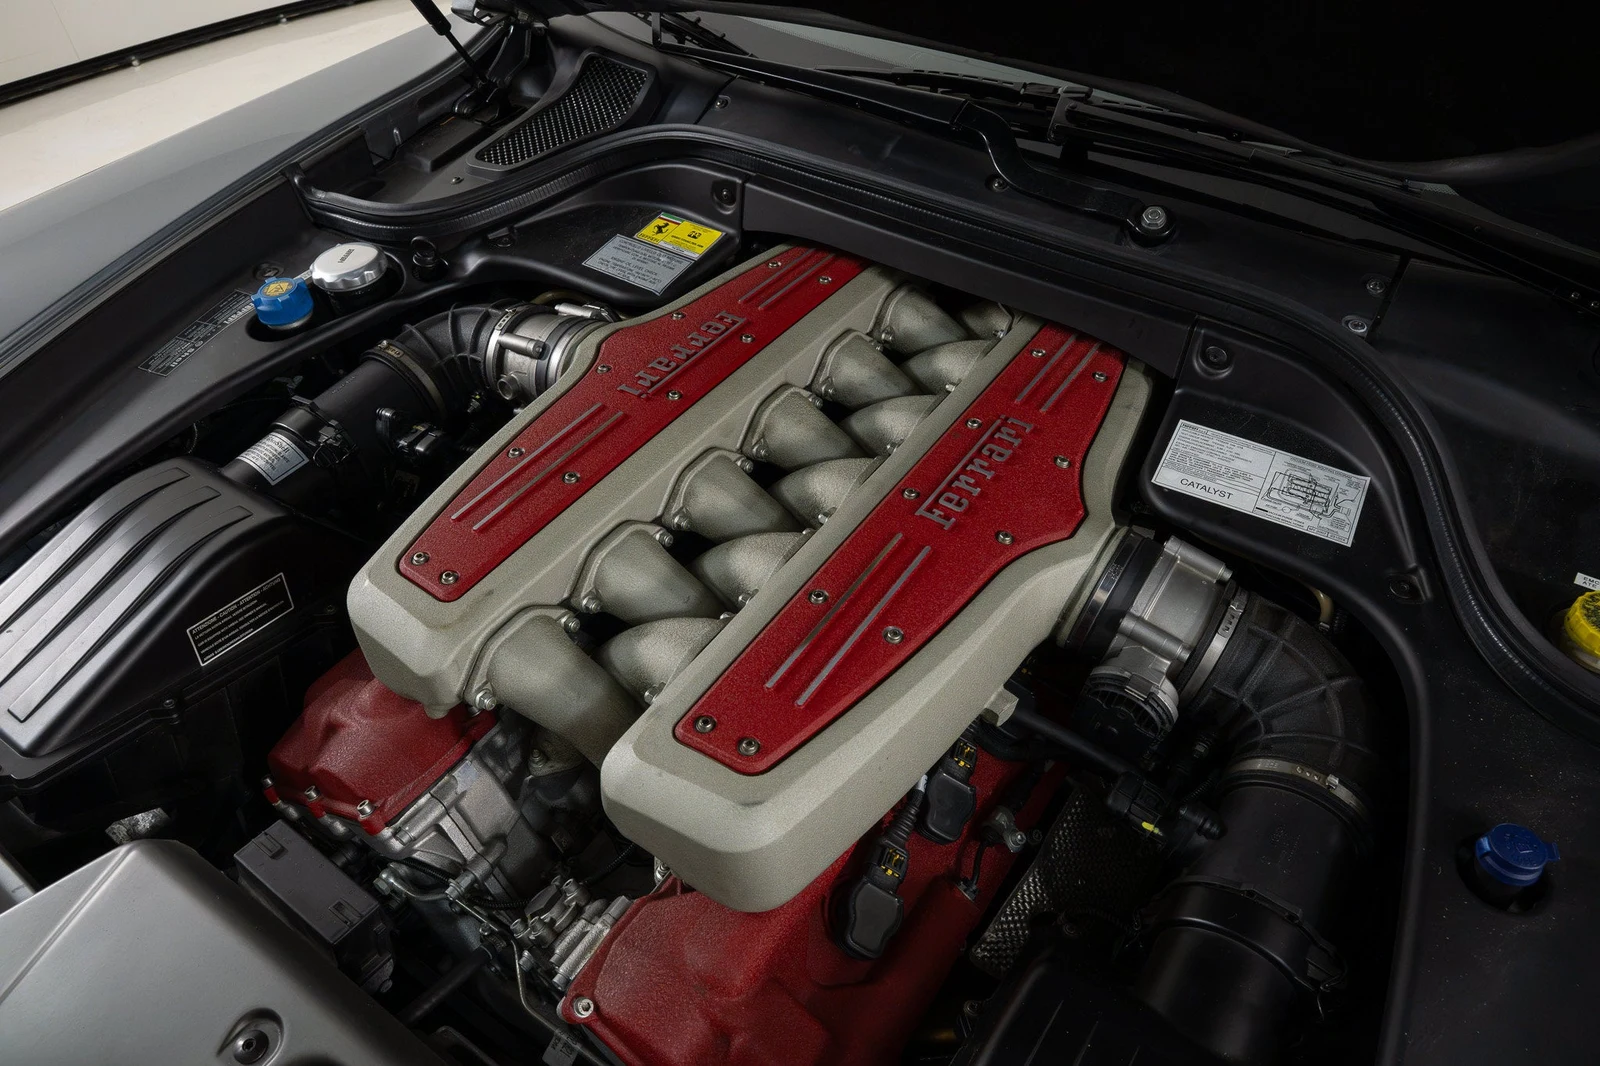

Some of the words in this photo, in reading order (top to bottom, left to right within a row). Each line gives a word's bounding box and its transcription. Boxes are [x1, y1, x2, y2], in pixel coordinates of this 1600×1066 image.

[170, 348, 195, 368] Shell
[617, 310, 747, 399] Ferrari
[915, 414, 1034, 530] Ferrari
[1180, 478, 1234, 500] CATALYST
